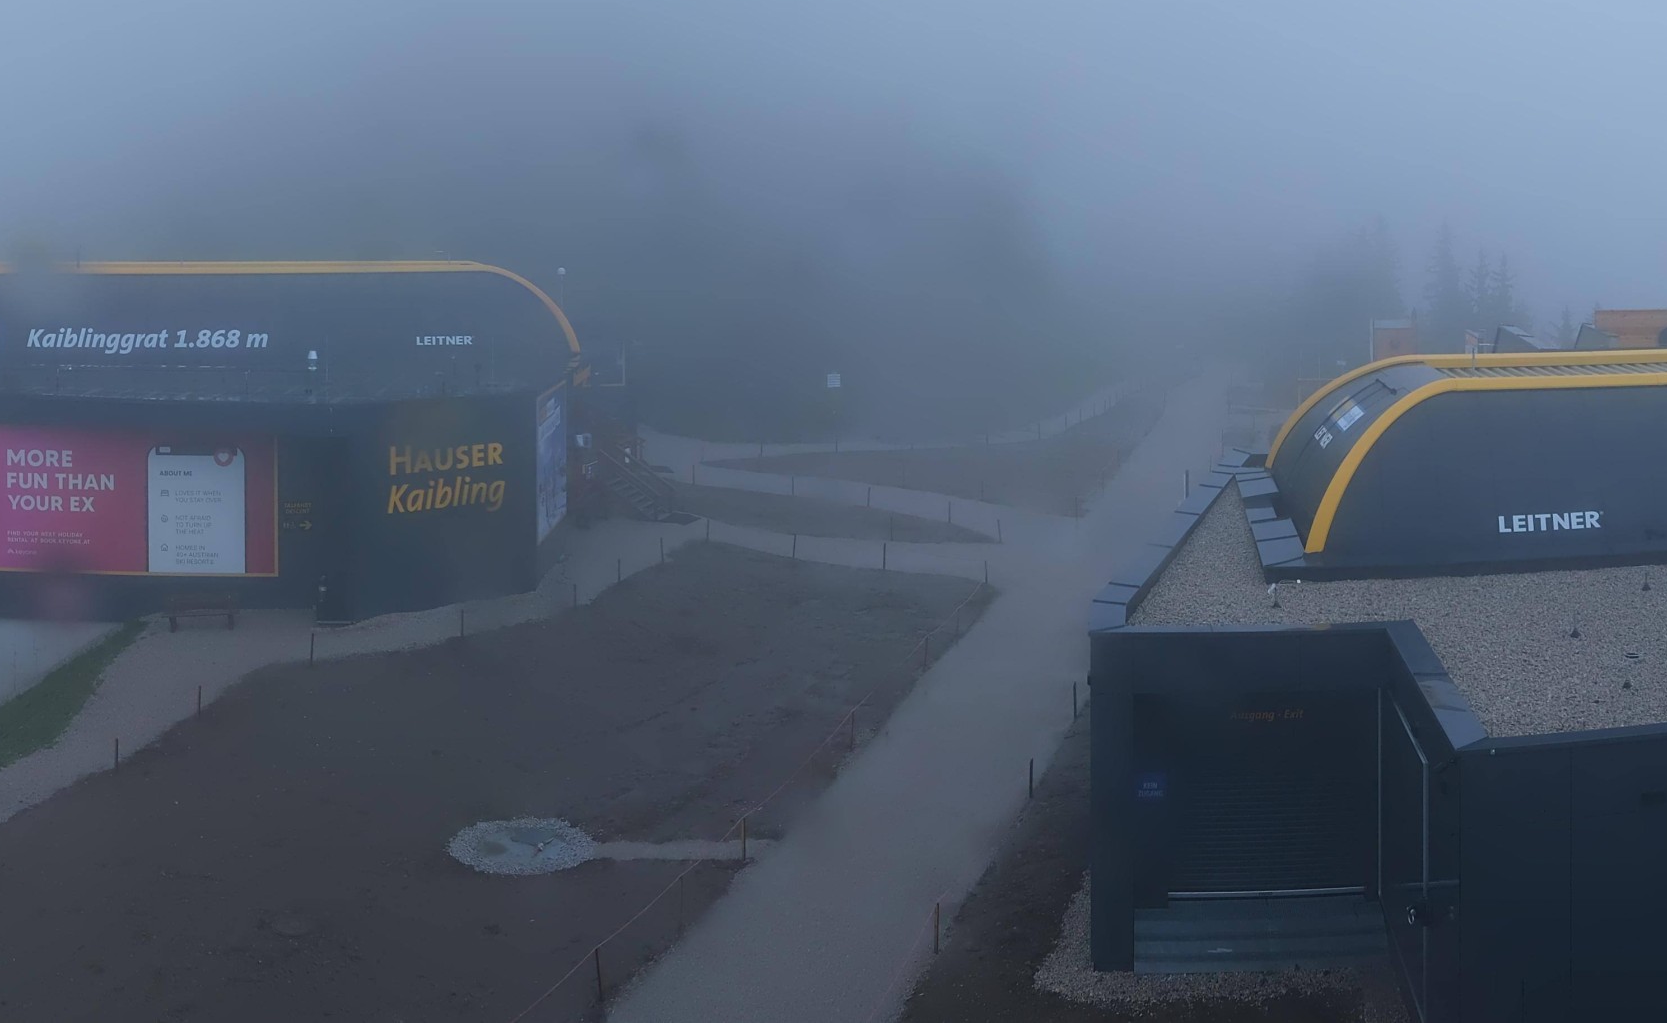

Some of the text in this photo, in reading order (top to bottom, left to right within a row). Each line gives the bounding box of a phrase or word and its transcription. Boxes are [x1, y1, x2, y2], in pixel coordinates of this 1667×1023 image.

[26, 327, 269, 354] Kaiblinggrat 1.868 m
[416, 335, 473, 346] LEITNER
[6, 449, 73, 467] MORE
[390, 442, 504, 476] HAUSER
[6, 472, 115, 491] FUN THAN
[7, 495, 95, 512] YOUR EX
[387, 476, 506, 514] Kaibling
[1498, 511, 1601, 533] LEITNER
[1284, 708, 1304, 719] Exit
